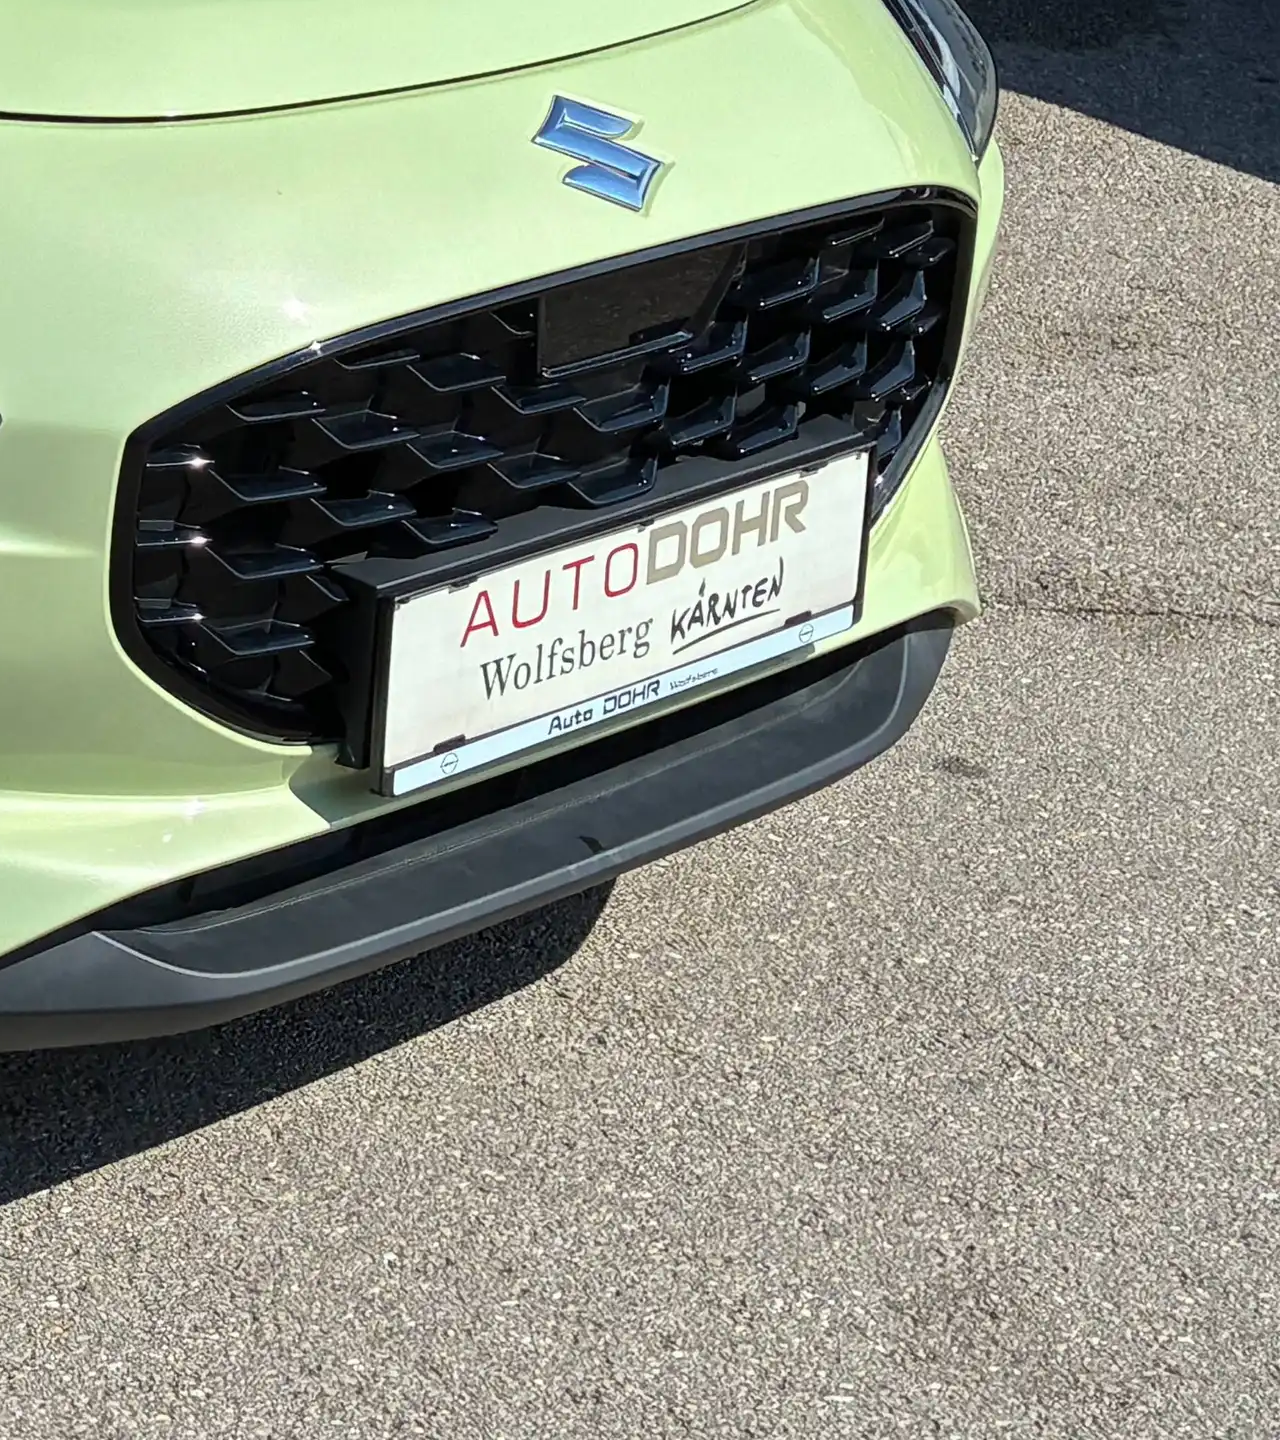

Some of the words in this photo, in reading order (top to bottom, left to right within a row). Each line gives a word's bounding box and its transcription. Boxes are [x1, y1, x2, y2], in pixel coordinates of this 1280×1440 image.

[479, 618, 654, 701] Wolfsberg
[547, 709, 594, 736] Auto
[602, 679, 661, 712] DOHR
